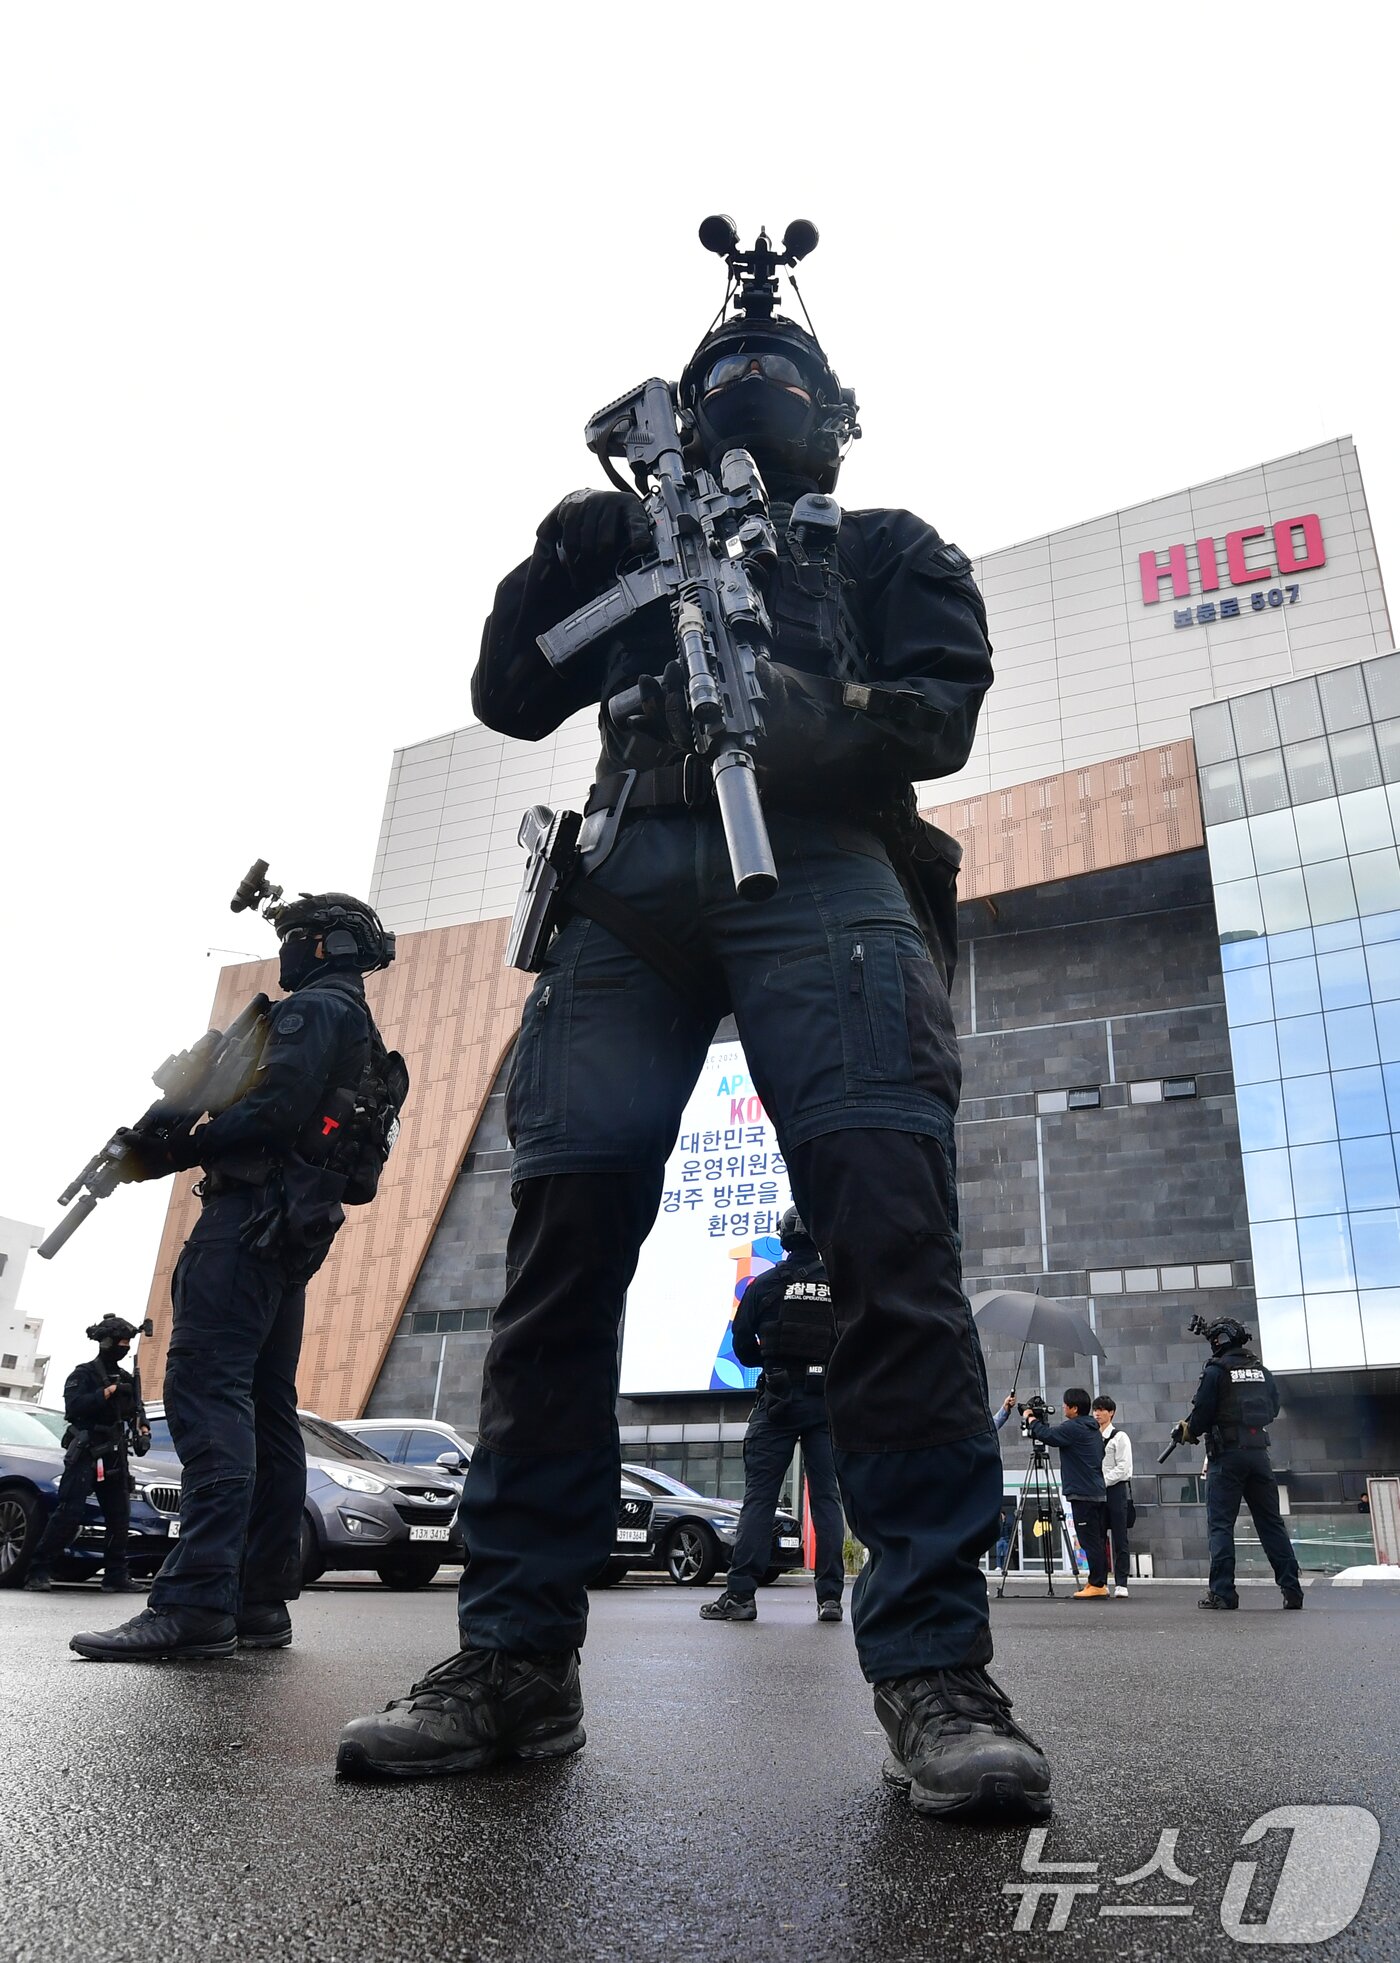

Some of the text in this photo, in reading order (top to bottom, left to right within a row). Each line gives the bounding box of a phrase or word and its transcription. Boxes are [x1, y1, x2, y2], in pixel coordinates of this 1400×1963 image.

[1138, 513, 1326, 606] HICO
[1173, 584, 1300, 629] 보문로 507
[680, 1126, 766, 1154] 대한민국
[662, 1188, 704, 1213] 경주
[714, 1181, 779, 1209] 방문을
[707, 1210, 780, 1238] 환영합
